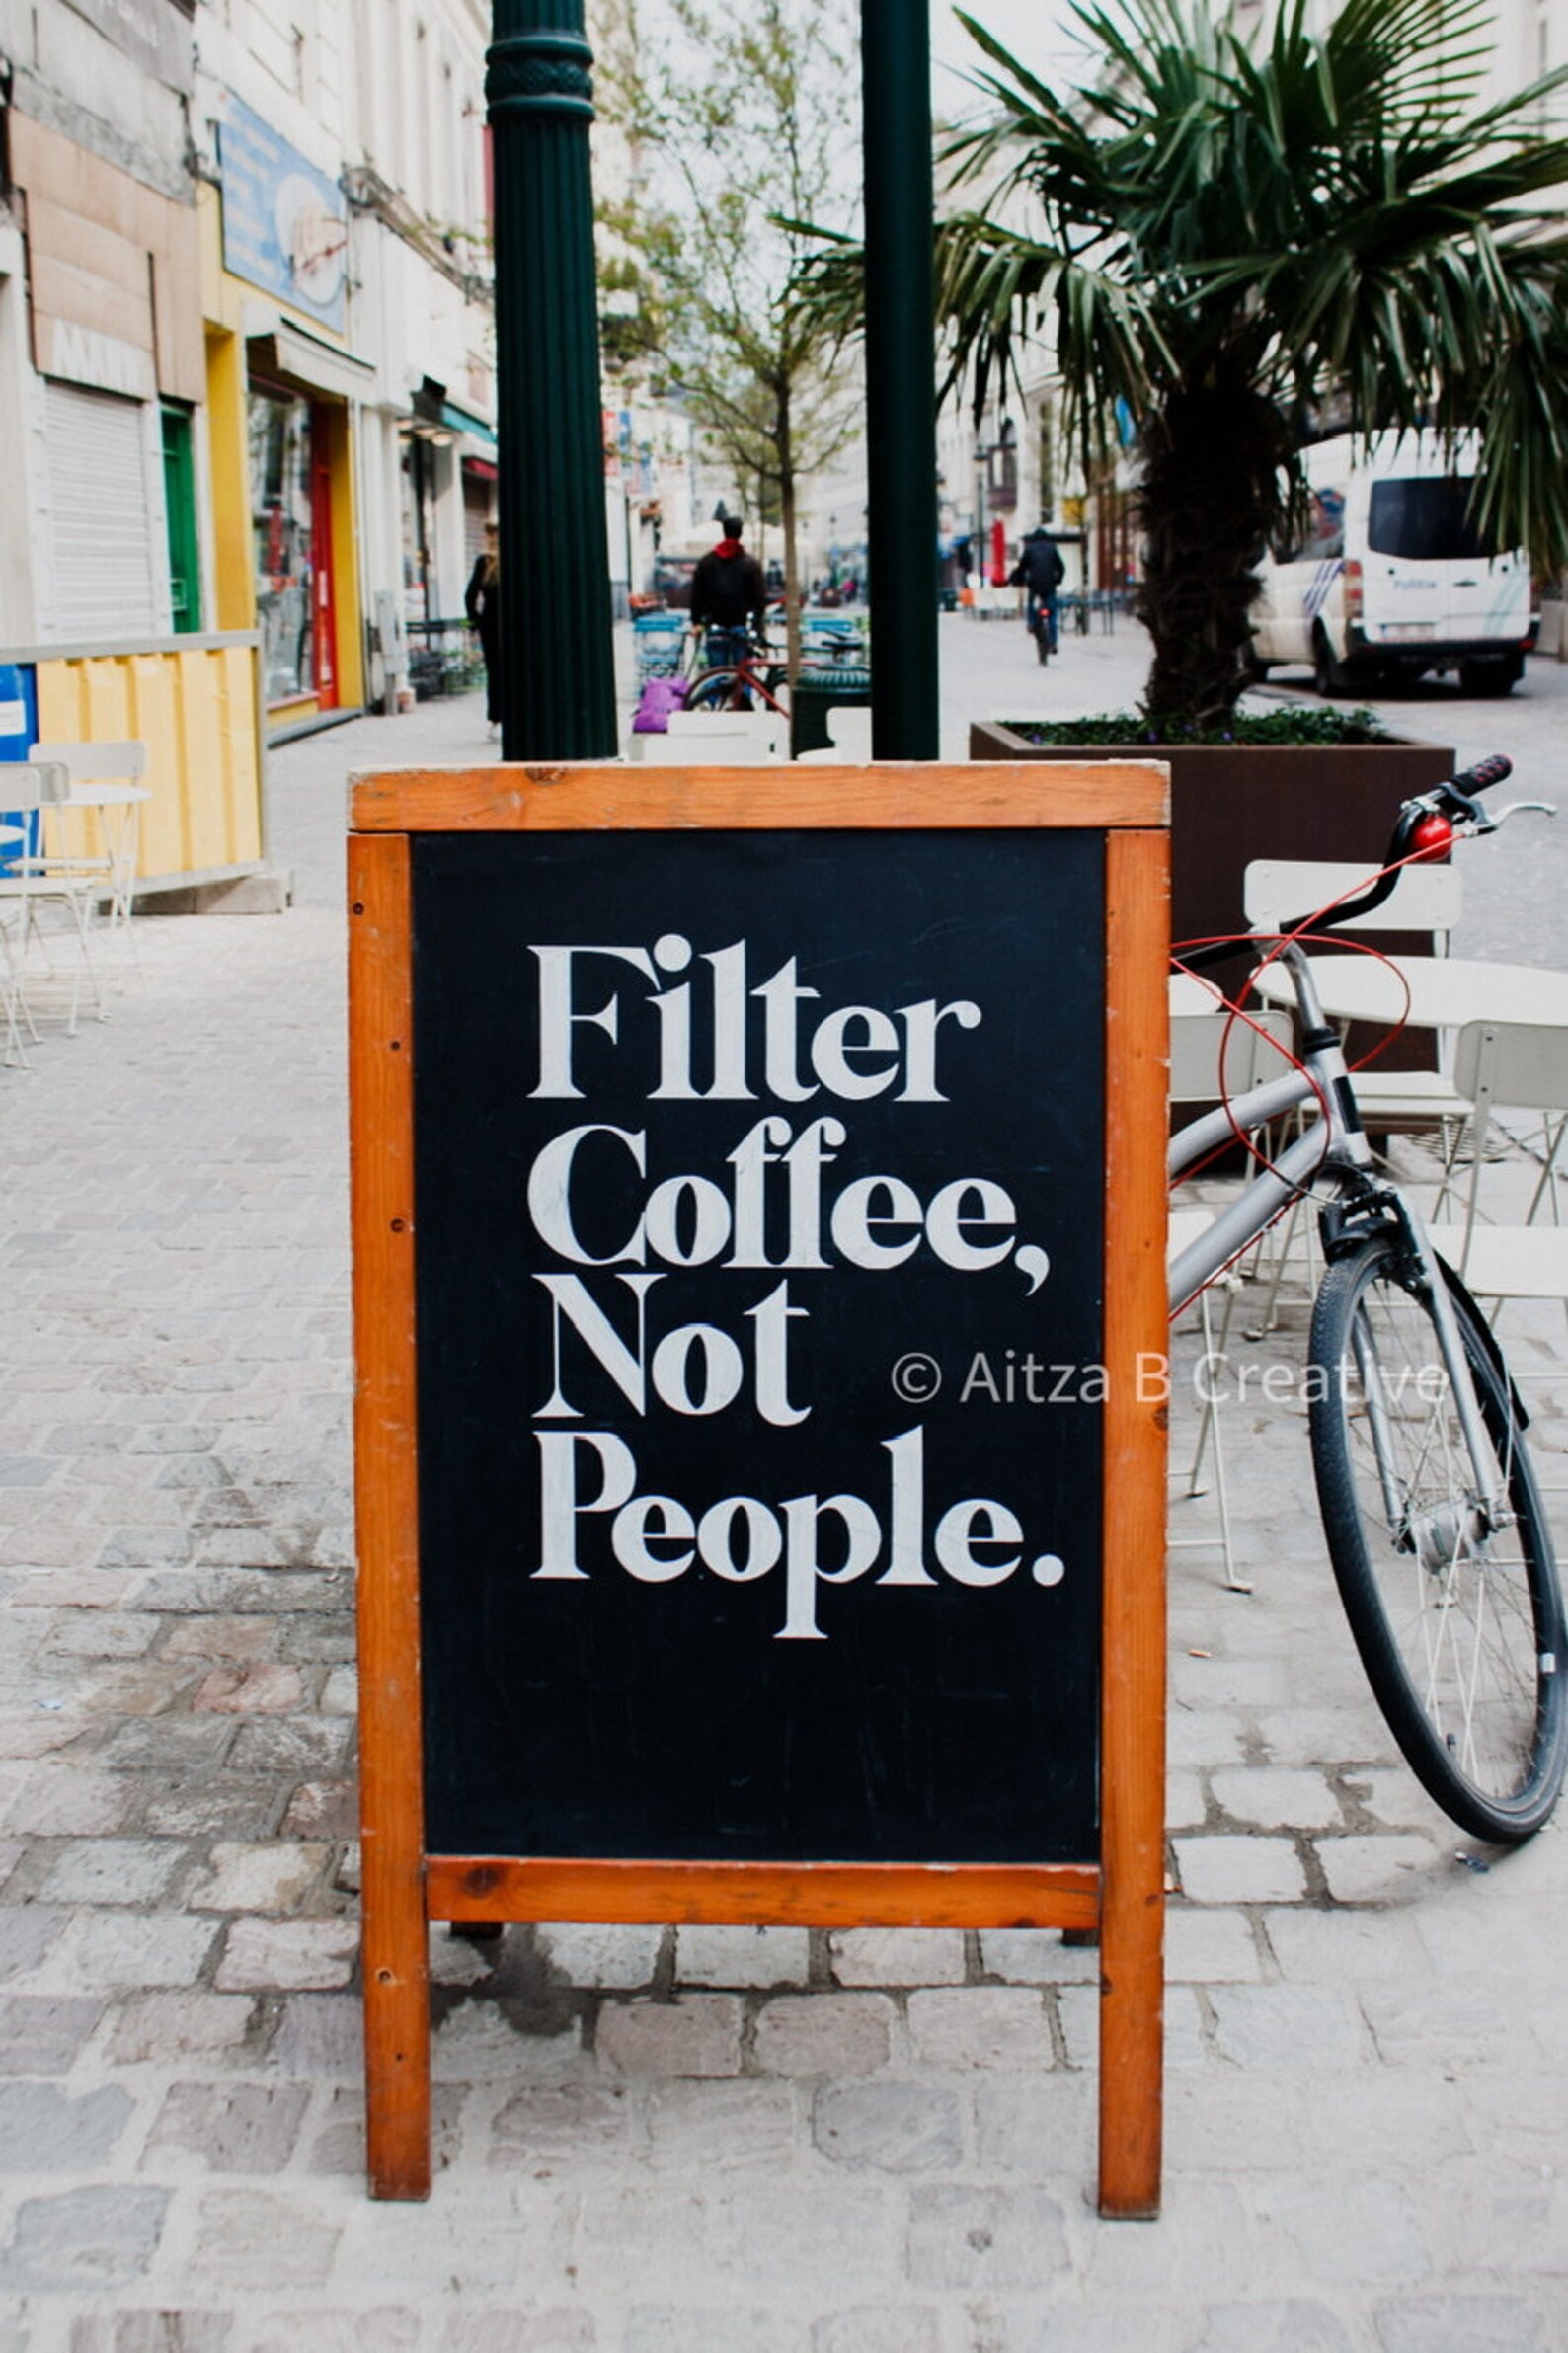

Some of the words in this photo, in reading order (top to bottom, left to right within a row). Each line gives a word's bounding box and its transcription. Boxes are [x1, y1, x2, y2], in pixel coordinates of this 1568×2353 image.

[526, 933, 982, 1102] Filter
[527, 1116, 1050, 1295] Coffee,
[531, 1273, 813, 1426] Not
[529, 1425, 1065, 1639] People.
